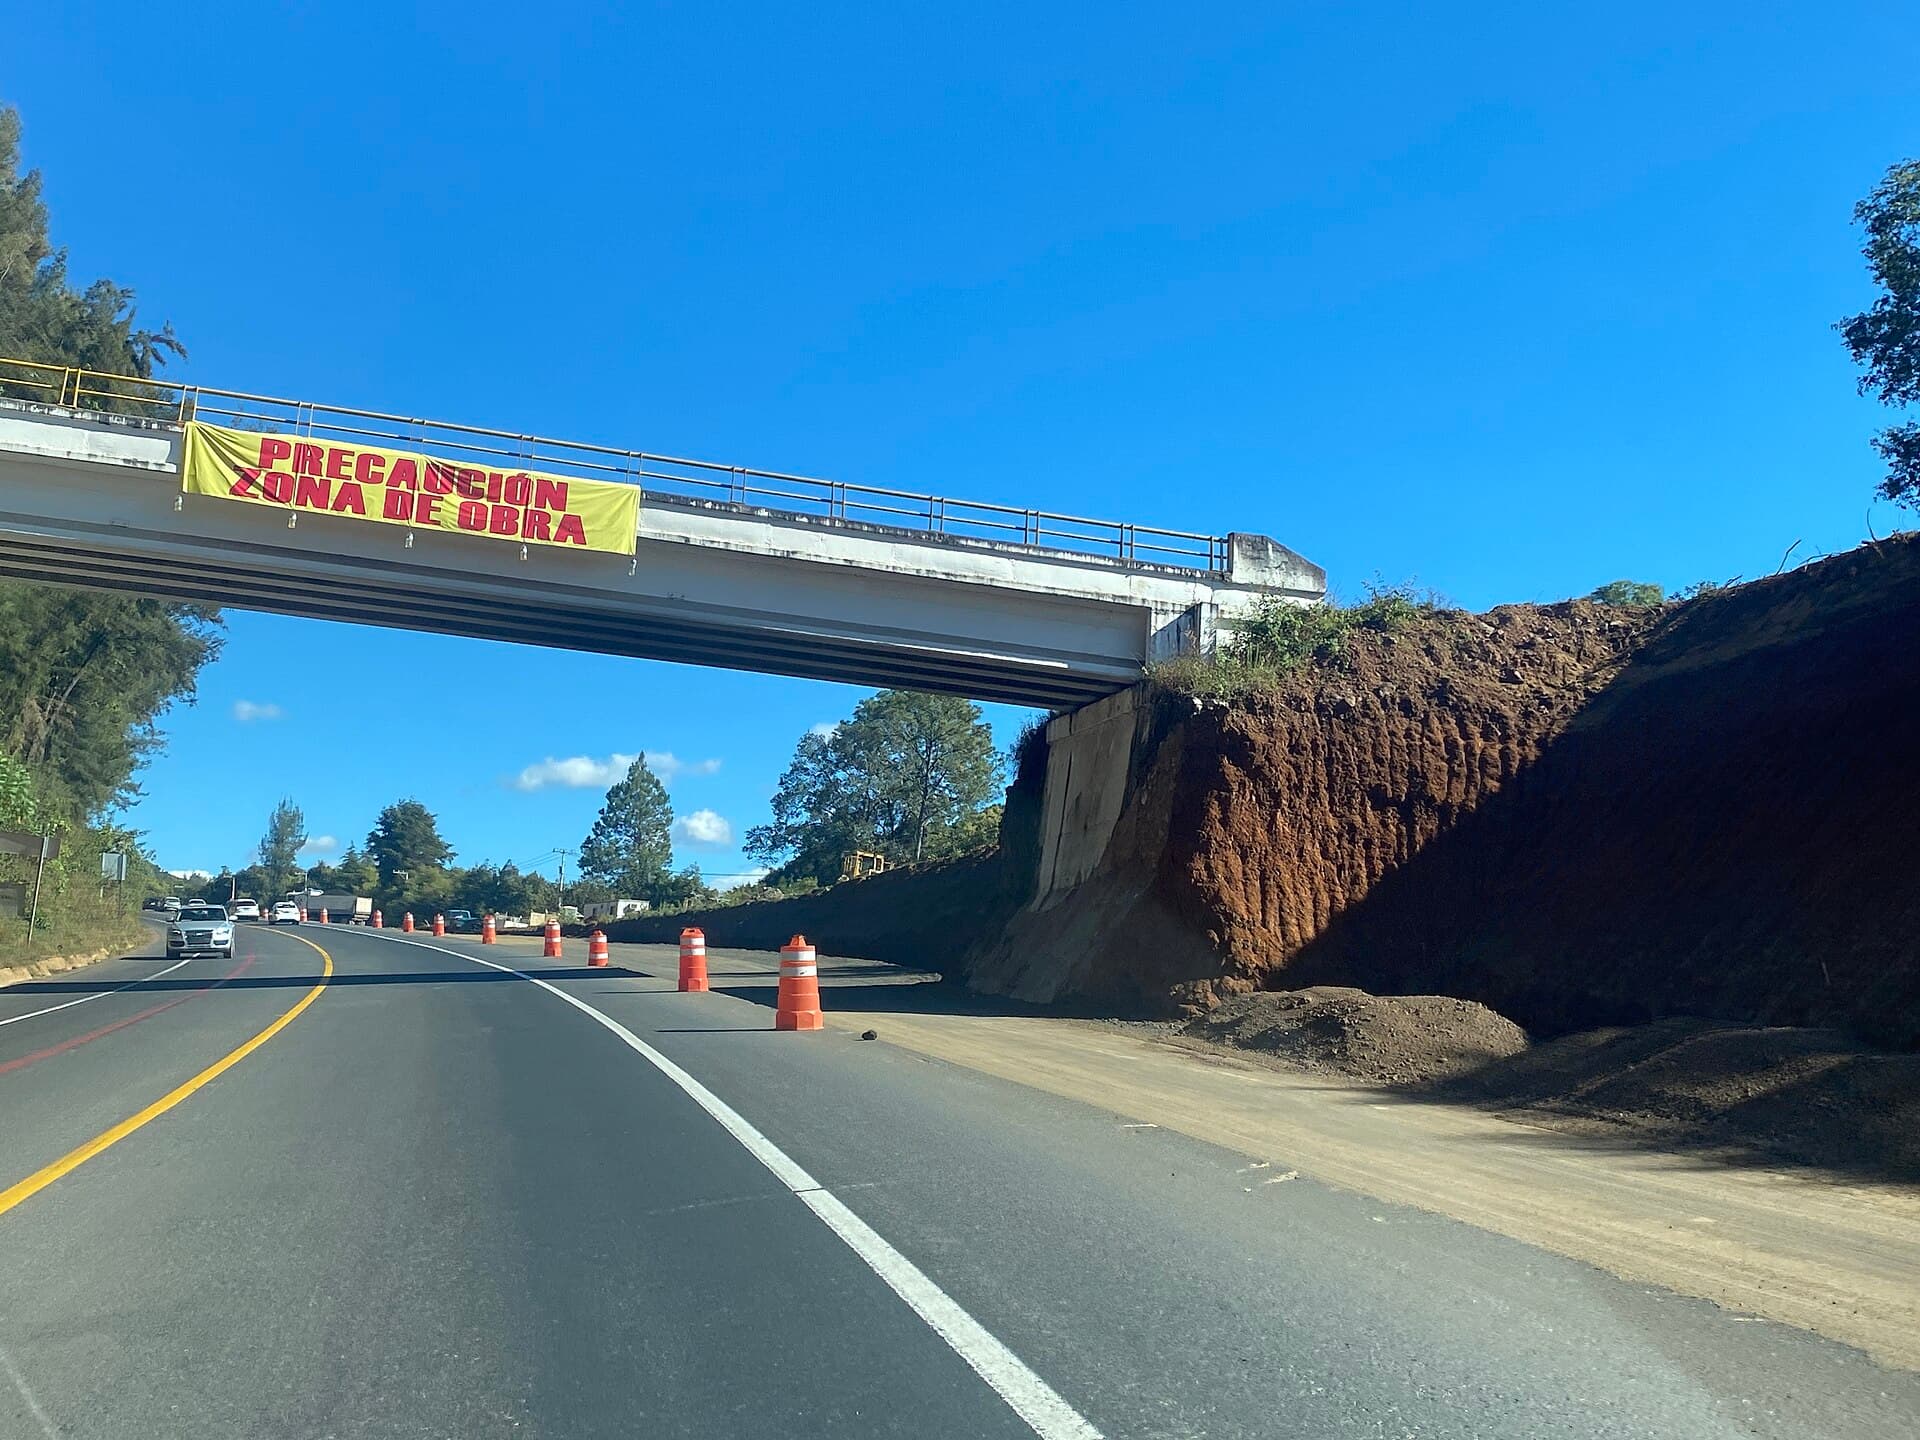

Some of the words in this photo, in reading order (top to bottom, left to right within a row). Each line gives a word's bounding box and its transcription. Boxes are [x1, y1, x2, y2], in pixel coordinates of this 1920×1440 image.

[229, 466, 366, 515] ZONA
[383, 489, 442, 525] DE
[458, 502, 587, 545] OBRA
[258, 438, 569, 511] PRECAUCIÓN
